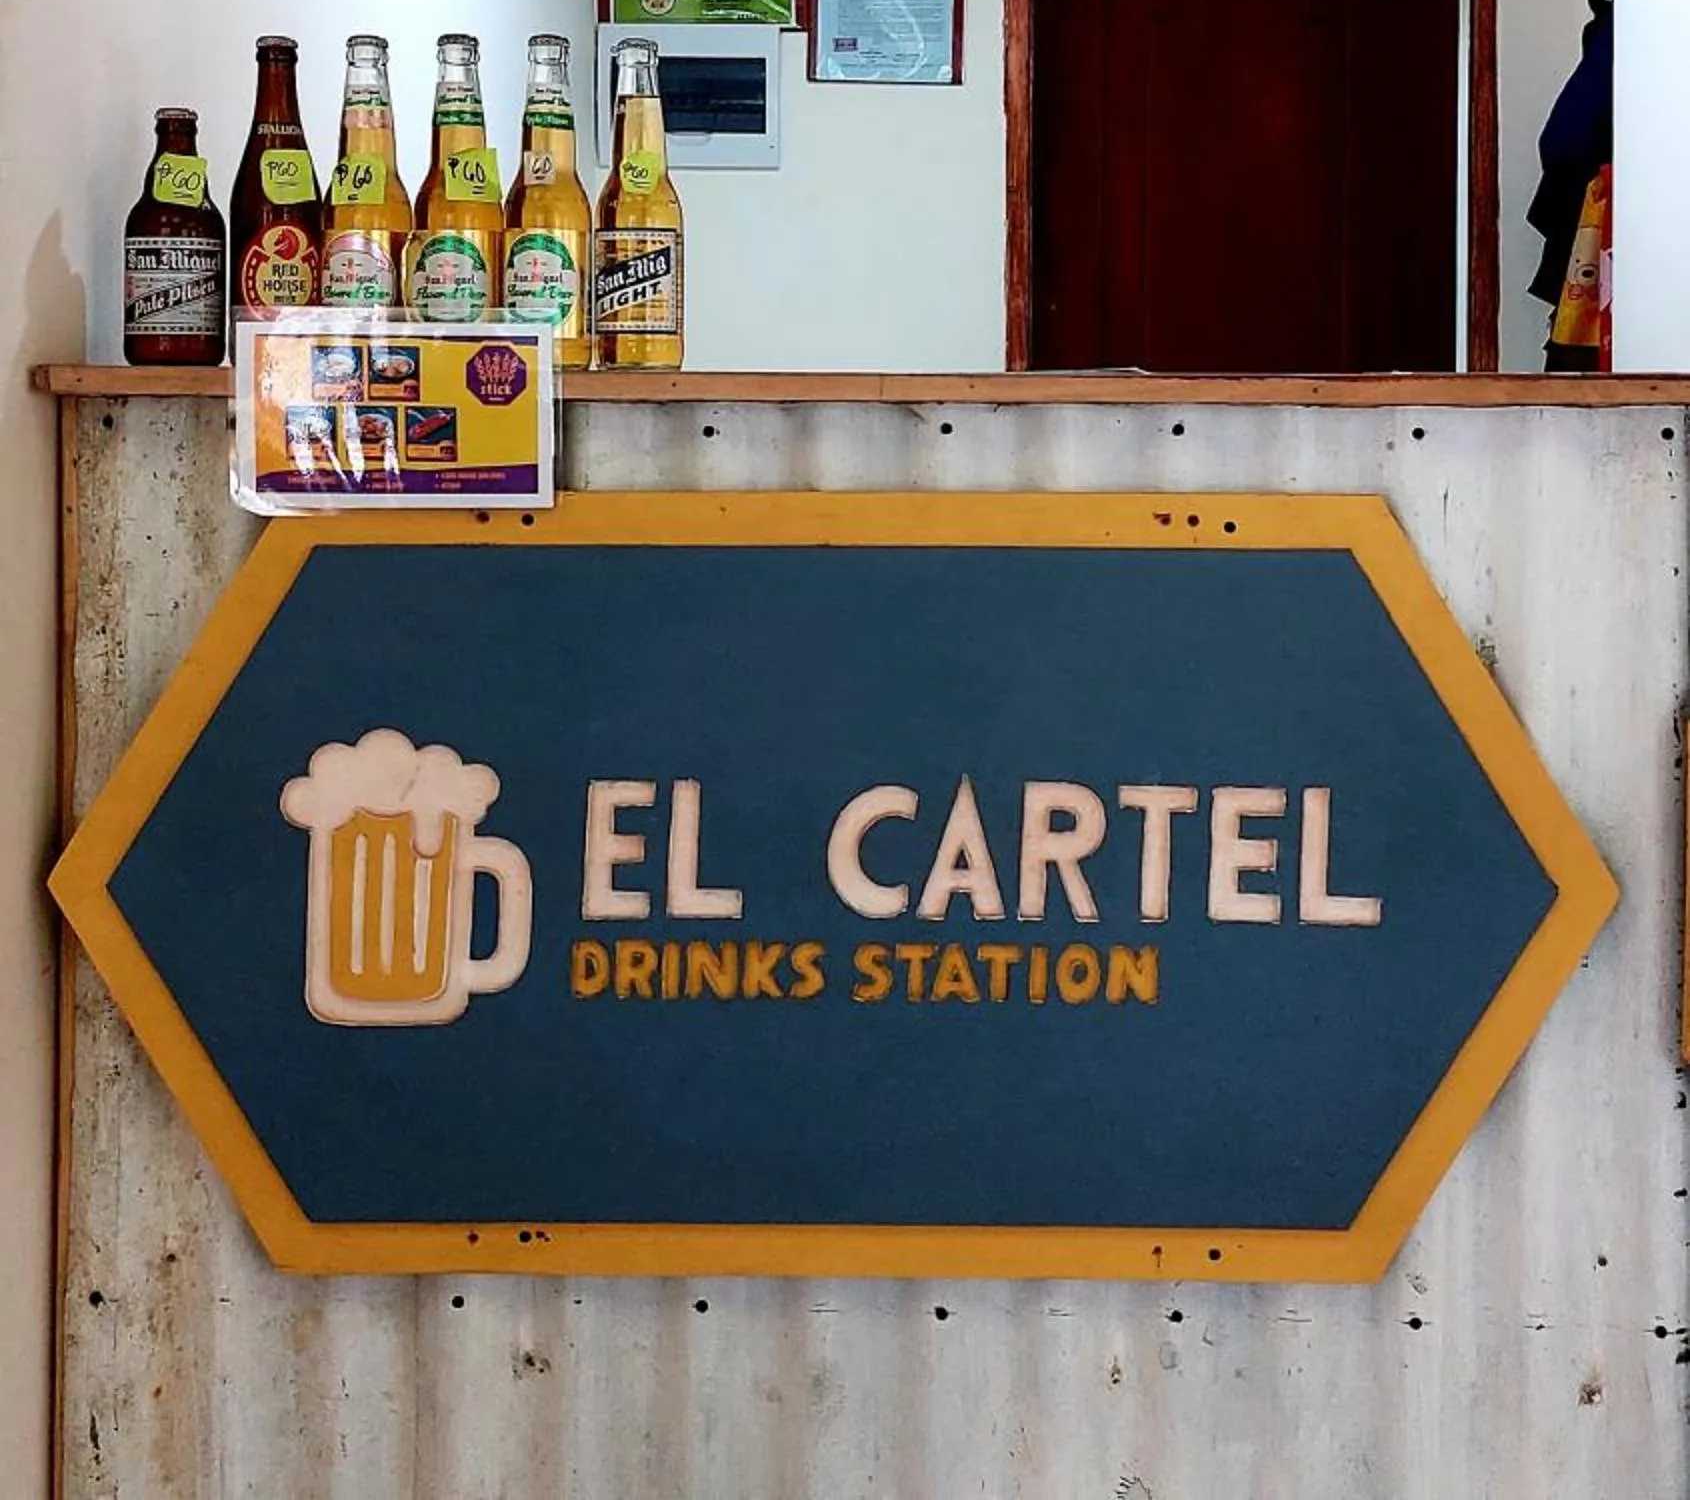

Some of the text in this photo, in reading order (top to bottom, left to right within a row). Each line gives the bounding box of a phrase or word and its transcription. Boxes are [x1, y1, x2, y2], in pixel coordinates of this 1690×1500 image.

[127, 249, 221, 271] San Miguel
[272, 263, 299, 279] RED
[597, 253, 667, 295] San Mig
[135, 279, 216, 319] Pale Pilsen
[263, 279, 308, 296] HORSE
[599, 280, 661, 315] LIGHT
[582, 772, 1384, 927] EL CARTEL
[570, 938, 1162, 1007] DRINKS STATION
